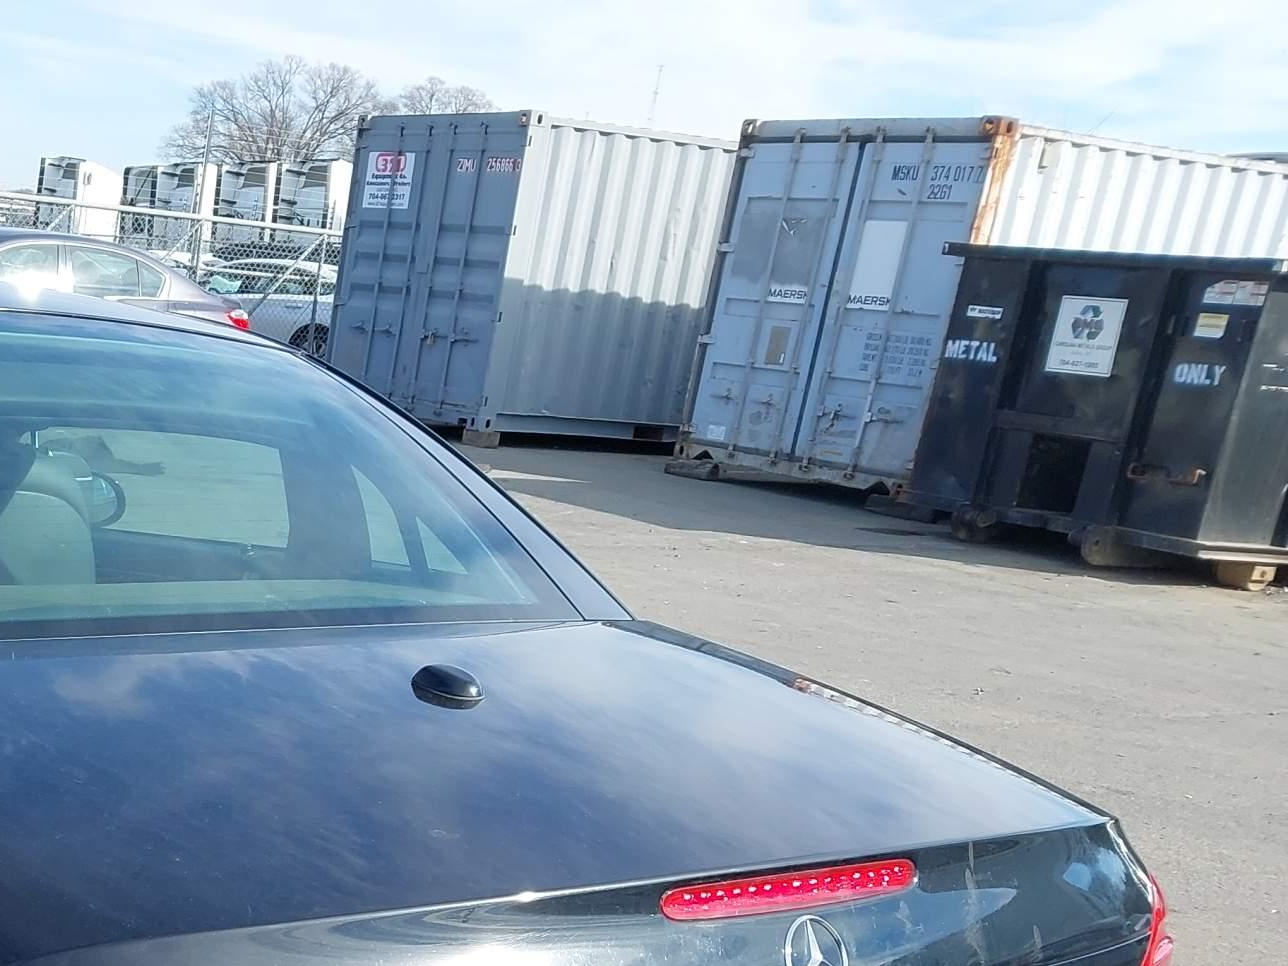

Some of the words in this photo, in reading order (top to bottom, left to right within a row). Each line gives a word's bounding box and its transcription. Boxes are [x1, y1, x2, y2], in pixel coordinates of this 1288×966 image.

[457, 158, 477, 172] ZIMU
[891, 165, 920, 181] MSKU
[931, 165, 951, 181] 374
[953, 166, 974, 182] 017
[927, 184, 952, 199] 22G1
[944, 340, 997, 362] METAL
[1174, 363, 1226, 386] ONLY
